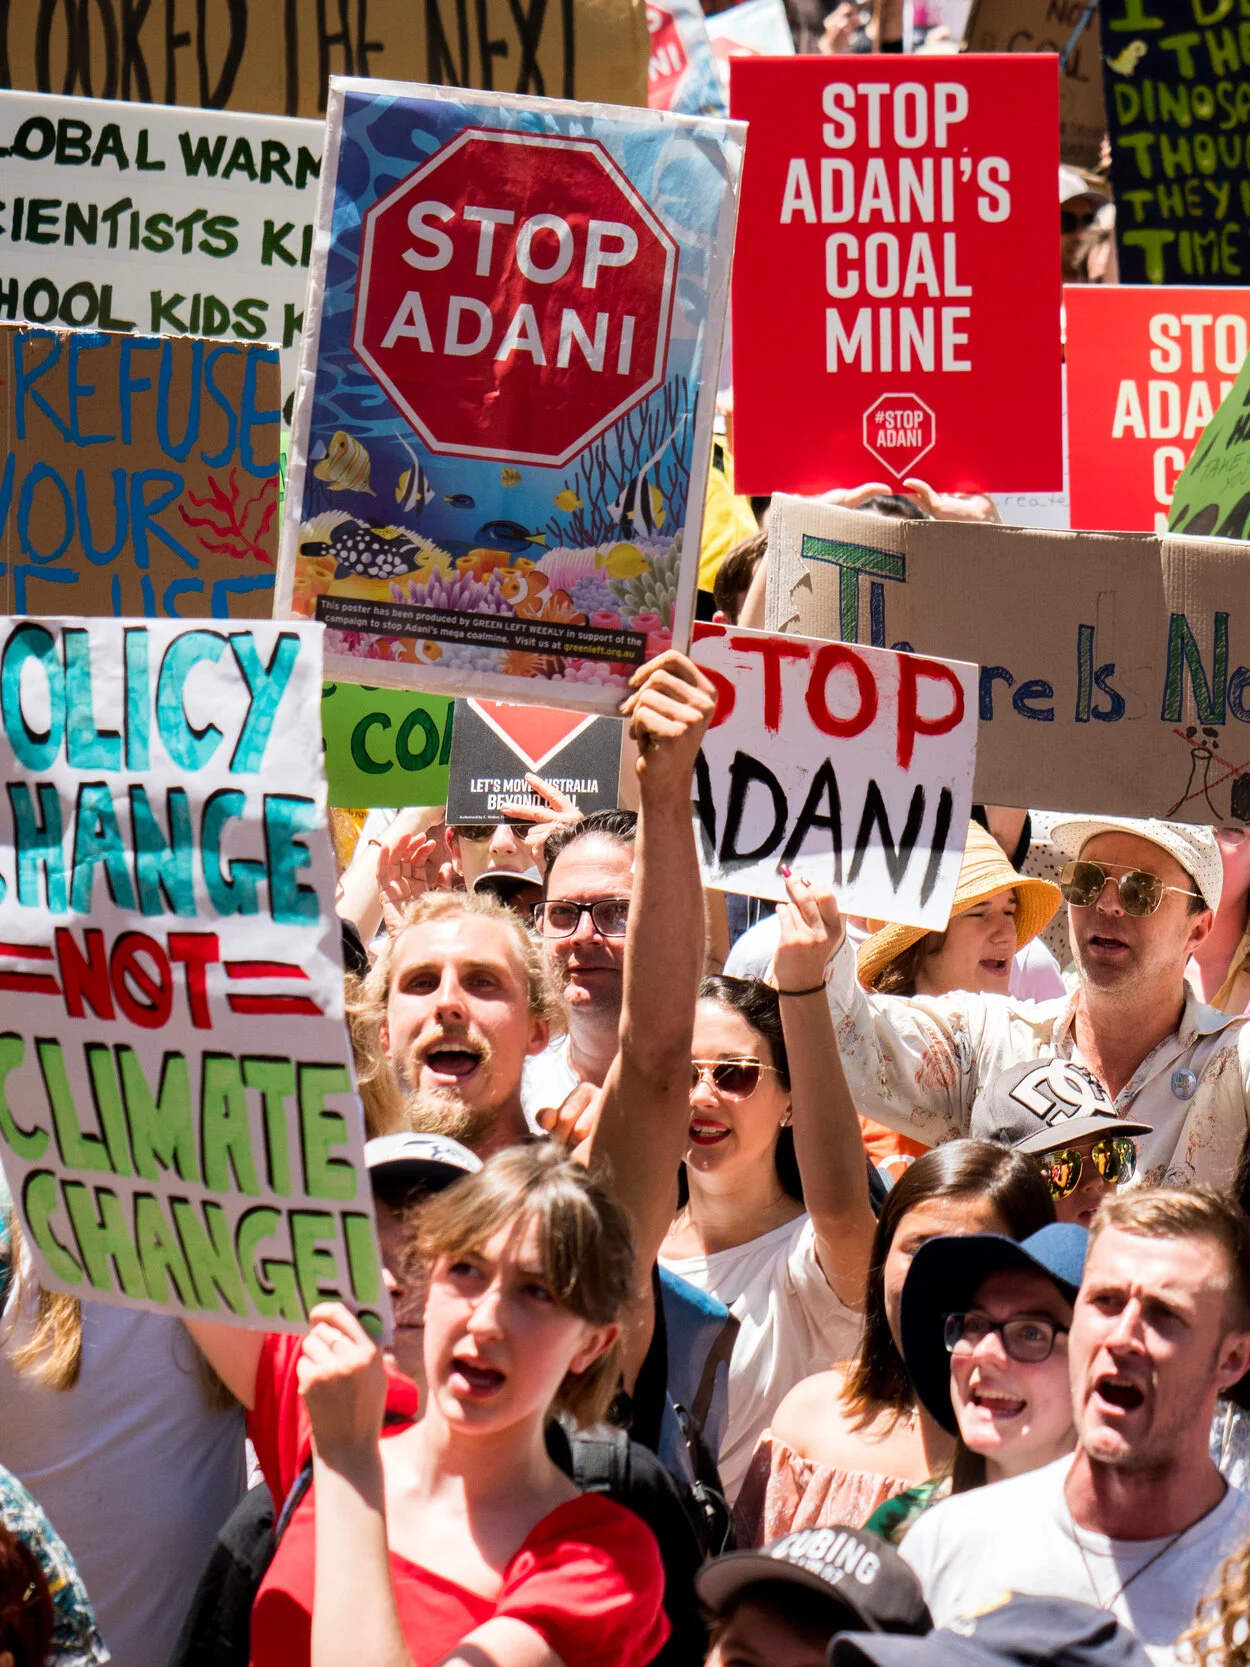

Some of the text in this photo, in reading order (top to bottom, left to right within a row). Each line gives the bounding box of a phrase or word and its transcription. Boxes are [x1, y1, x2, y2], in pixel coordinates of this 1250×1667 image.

[0, 116, 166, 171] OBAL
[822, 82, 969, 149] STOP
[780, 155, 1011, 225] ADANI'S
[1122, 179, 1231, 221] THEY
[0, 197, 240, 259] IENTISTS
[401, 199, 639, 289] STOP
[1123, 223, 1241, 284] TIME
[825, 232, 973, 298] COAL
[150, 290, 269, 340] KIDS
[379, 290, 635, 376] ADANI
[825, 307, 973, 373] MINE
[13, 328, 282, 478] REFUSE
[874, 410, 924, 429] #STOP
[1111, 379, 1234, 440] ADA
[876, 429, 923, 448] ADANI
[321, 600, 643, 647] This poster has been produced by GREEN LEFT WEEKLY in support of the
[324, 614, 368, 627] campaign
[370, 617, 380, 628] to
[382, 621, 403, 632] stop
[440, 628, 465, 639] mega
[515, 635, 536, 647] Visit
[538, 640, 549, 649] us
[551, 641, 562, 650] at
[563, 642, 636, 659] greenleft.org.au
[1, 622, 302, 775] OLICY
[471, 778, 501, 793] LET'S
[546, 778, 599, 794] STRALIA
[0, 780, 320, 926] HANGE
[54, 927, 221, 1030] NOT
[0, 1032, 357, 1201] CLIMATE
[22, 1168, 384, 1337] CHANGE!
